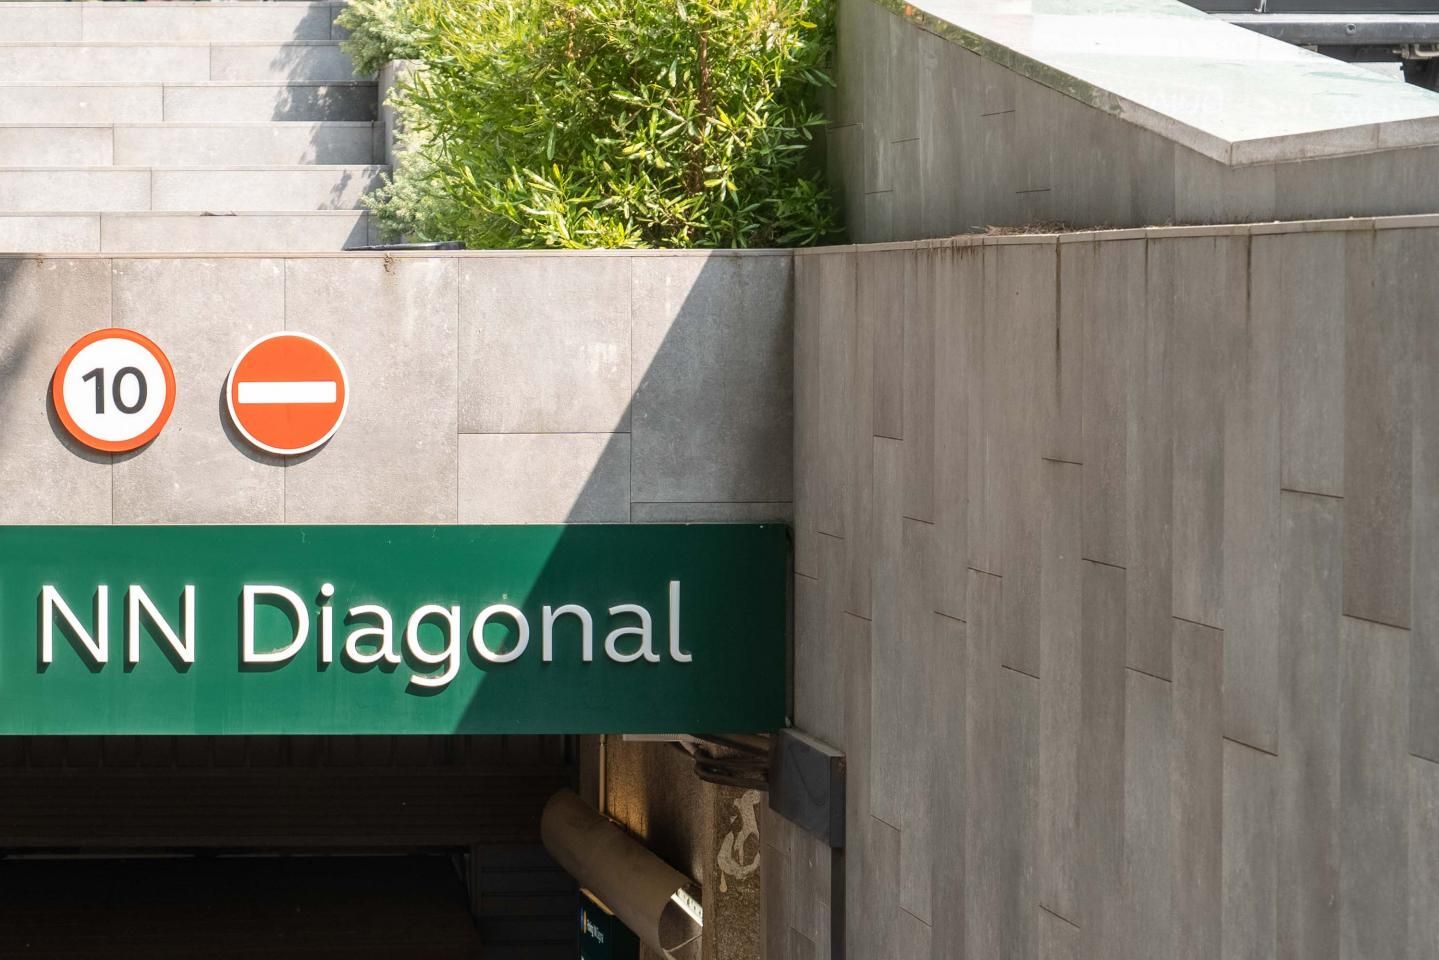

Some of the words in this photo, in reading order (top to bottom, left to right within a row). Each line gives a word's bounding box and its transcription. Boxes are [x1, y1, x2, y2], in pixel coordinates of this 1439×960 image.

[82, 367, 148, 414] 10
[41, 584, 196, 663] NN
[242, 581, 693, 688] Diagonal
